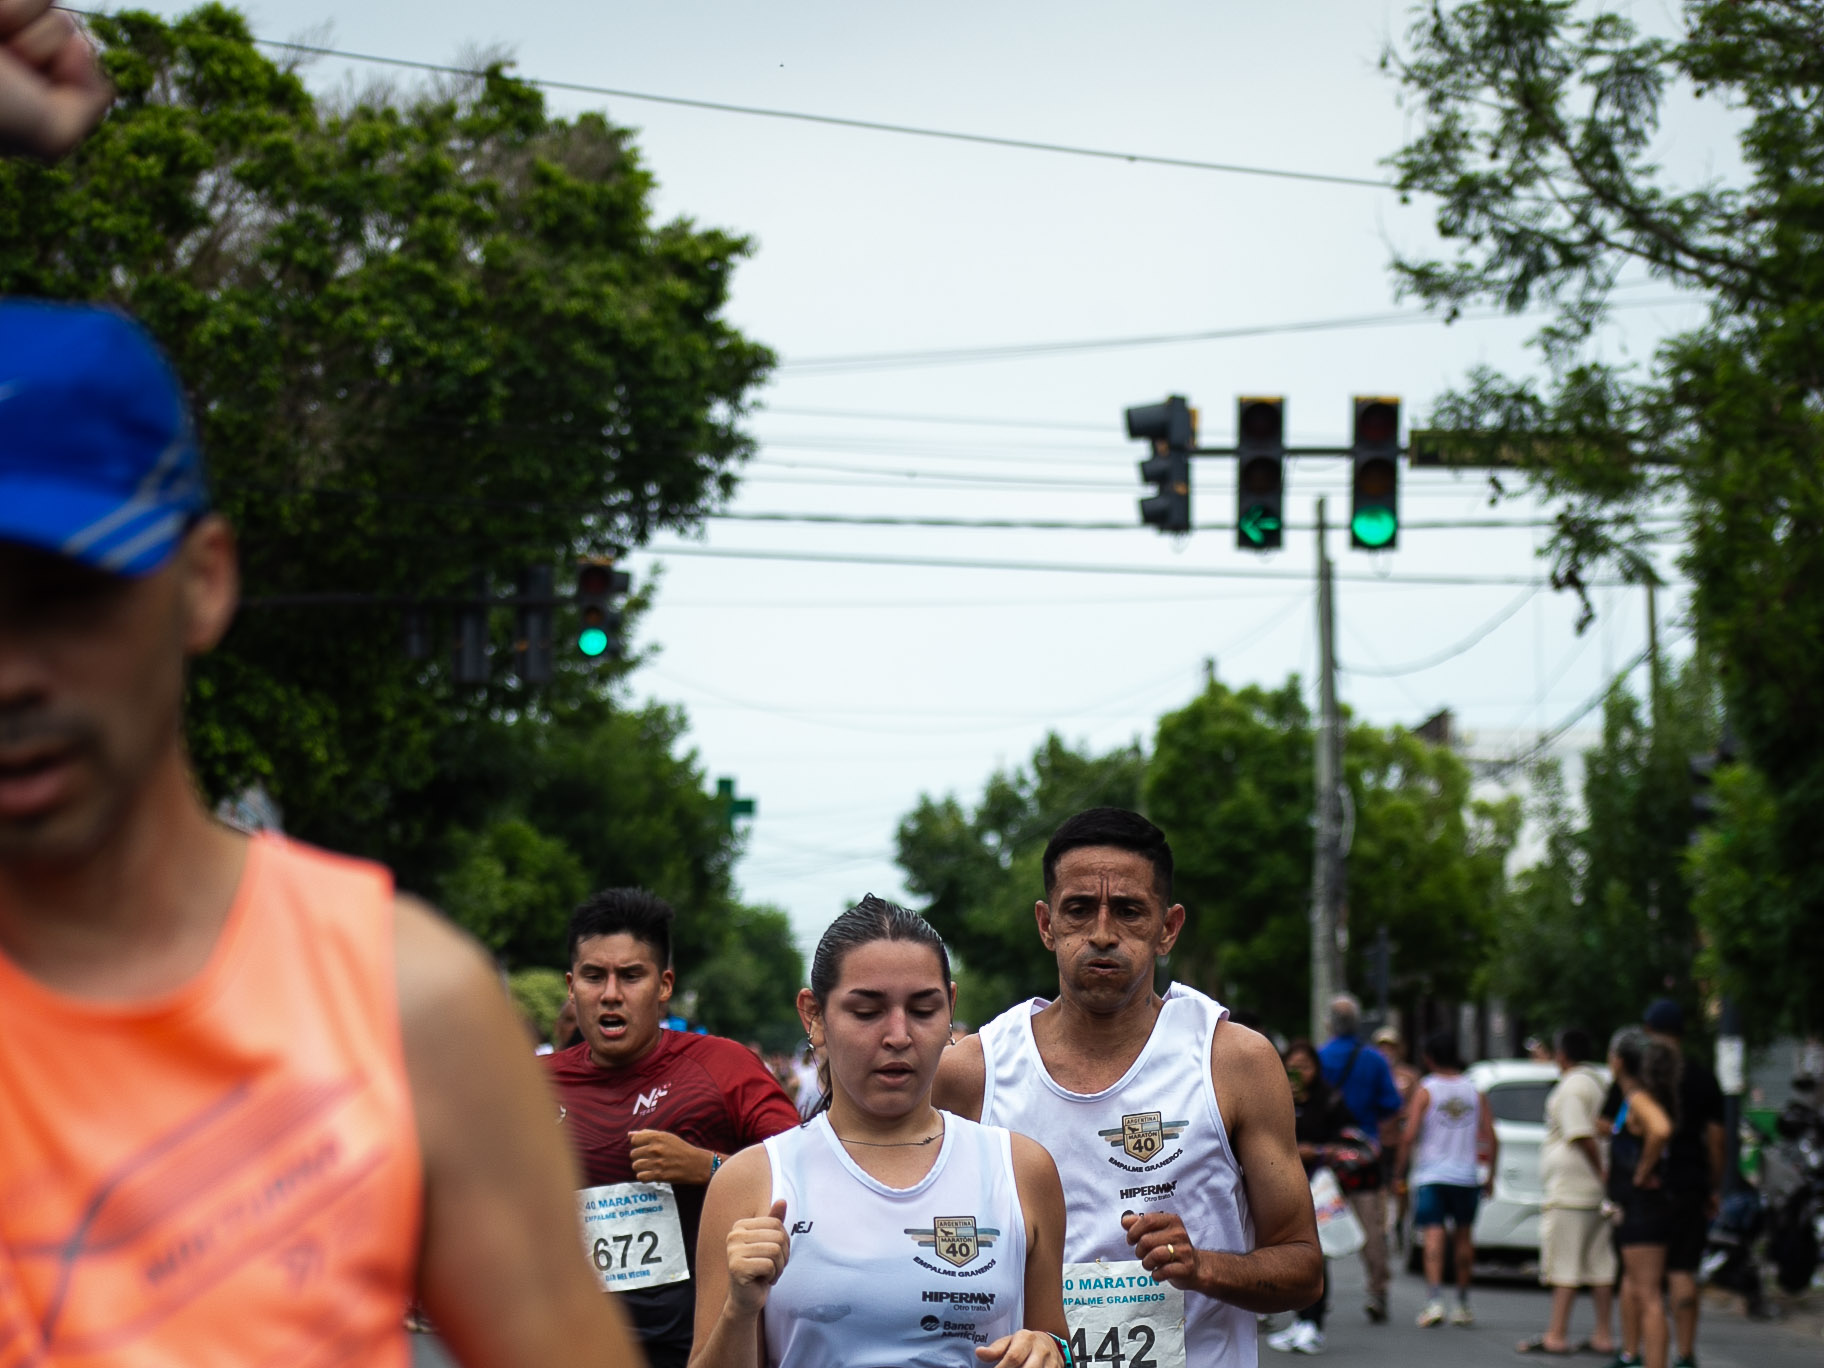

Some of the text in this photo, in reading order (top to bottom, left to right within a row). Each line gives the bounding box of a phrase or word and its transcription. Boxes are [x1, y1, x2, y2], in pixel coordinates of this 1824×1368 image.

[1127, 1116, 1156, 1124] ARGENTINA
[1132, 1138, 1155, 1153] 40
[1108, 1148, 1183, 1172] EMPALME GRANEROS
[586, 1193, 658, 1210] 40 MARATON
[593, 1230, 662, 1271] 672
[946, 1243, 970, 1257] 40
[913, 1256, 996, 1277] EMPALME GRANEROS
[1062, 1276, 1160, 1290] 0 MARATON
[1063, 1293, 1166, 1306] MPALME GRANEROS
[943, 1321, 975, 1331] Banco
